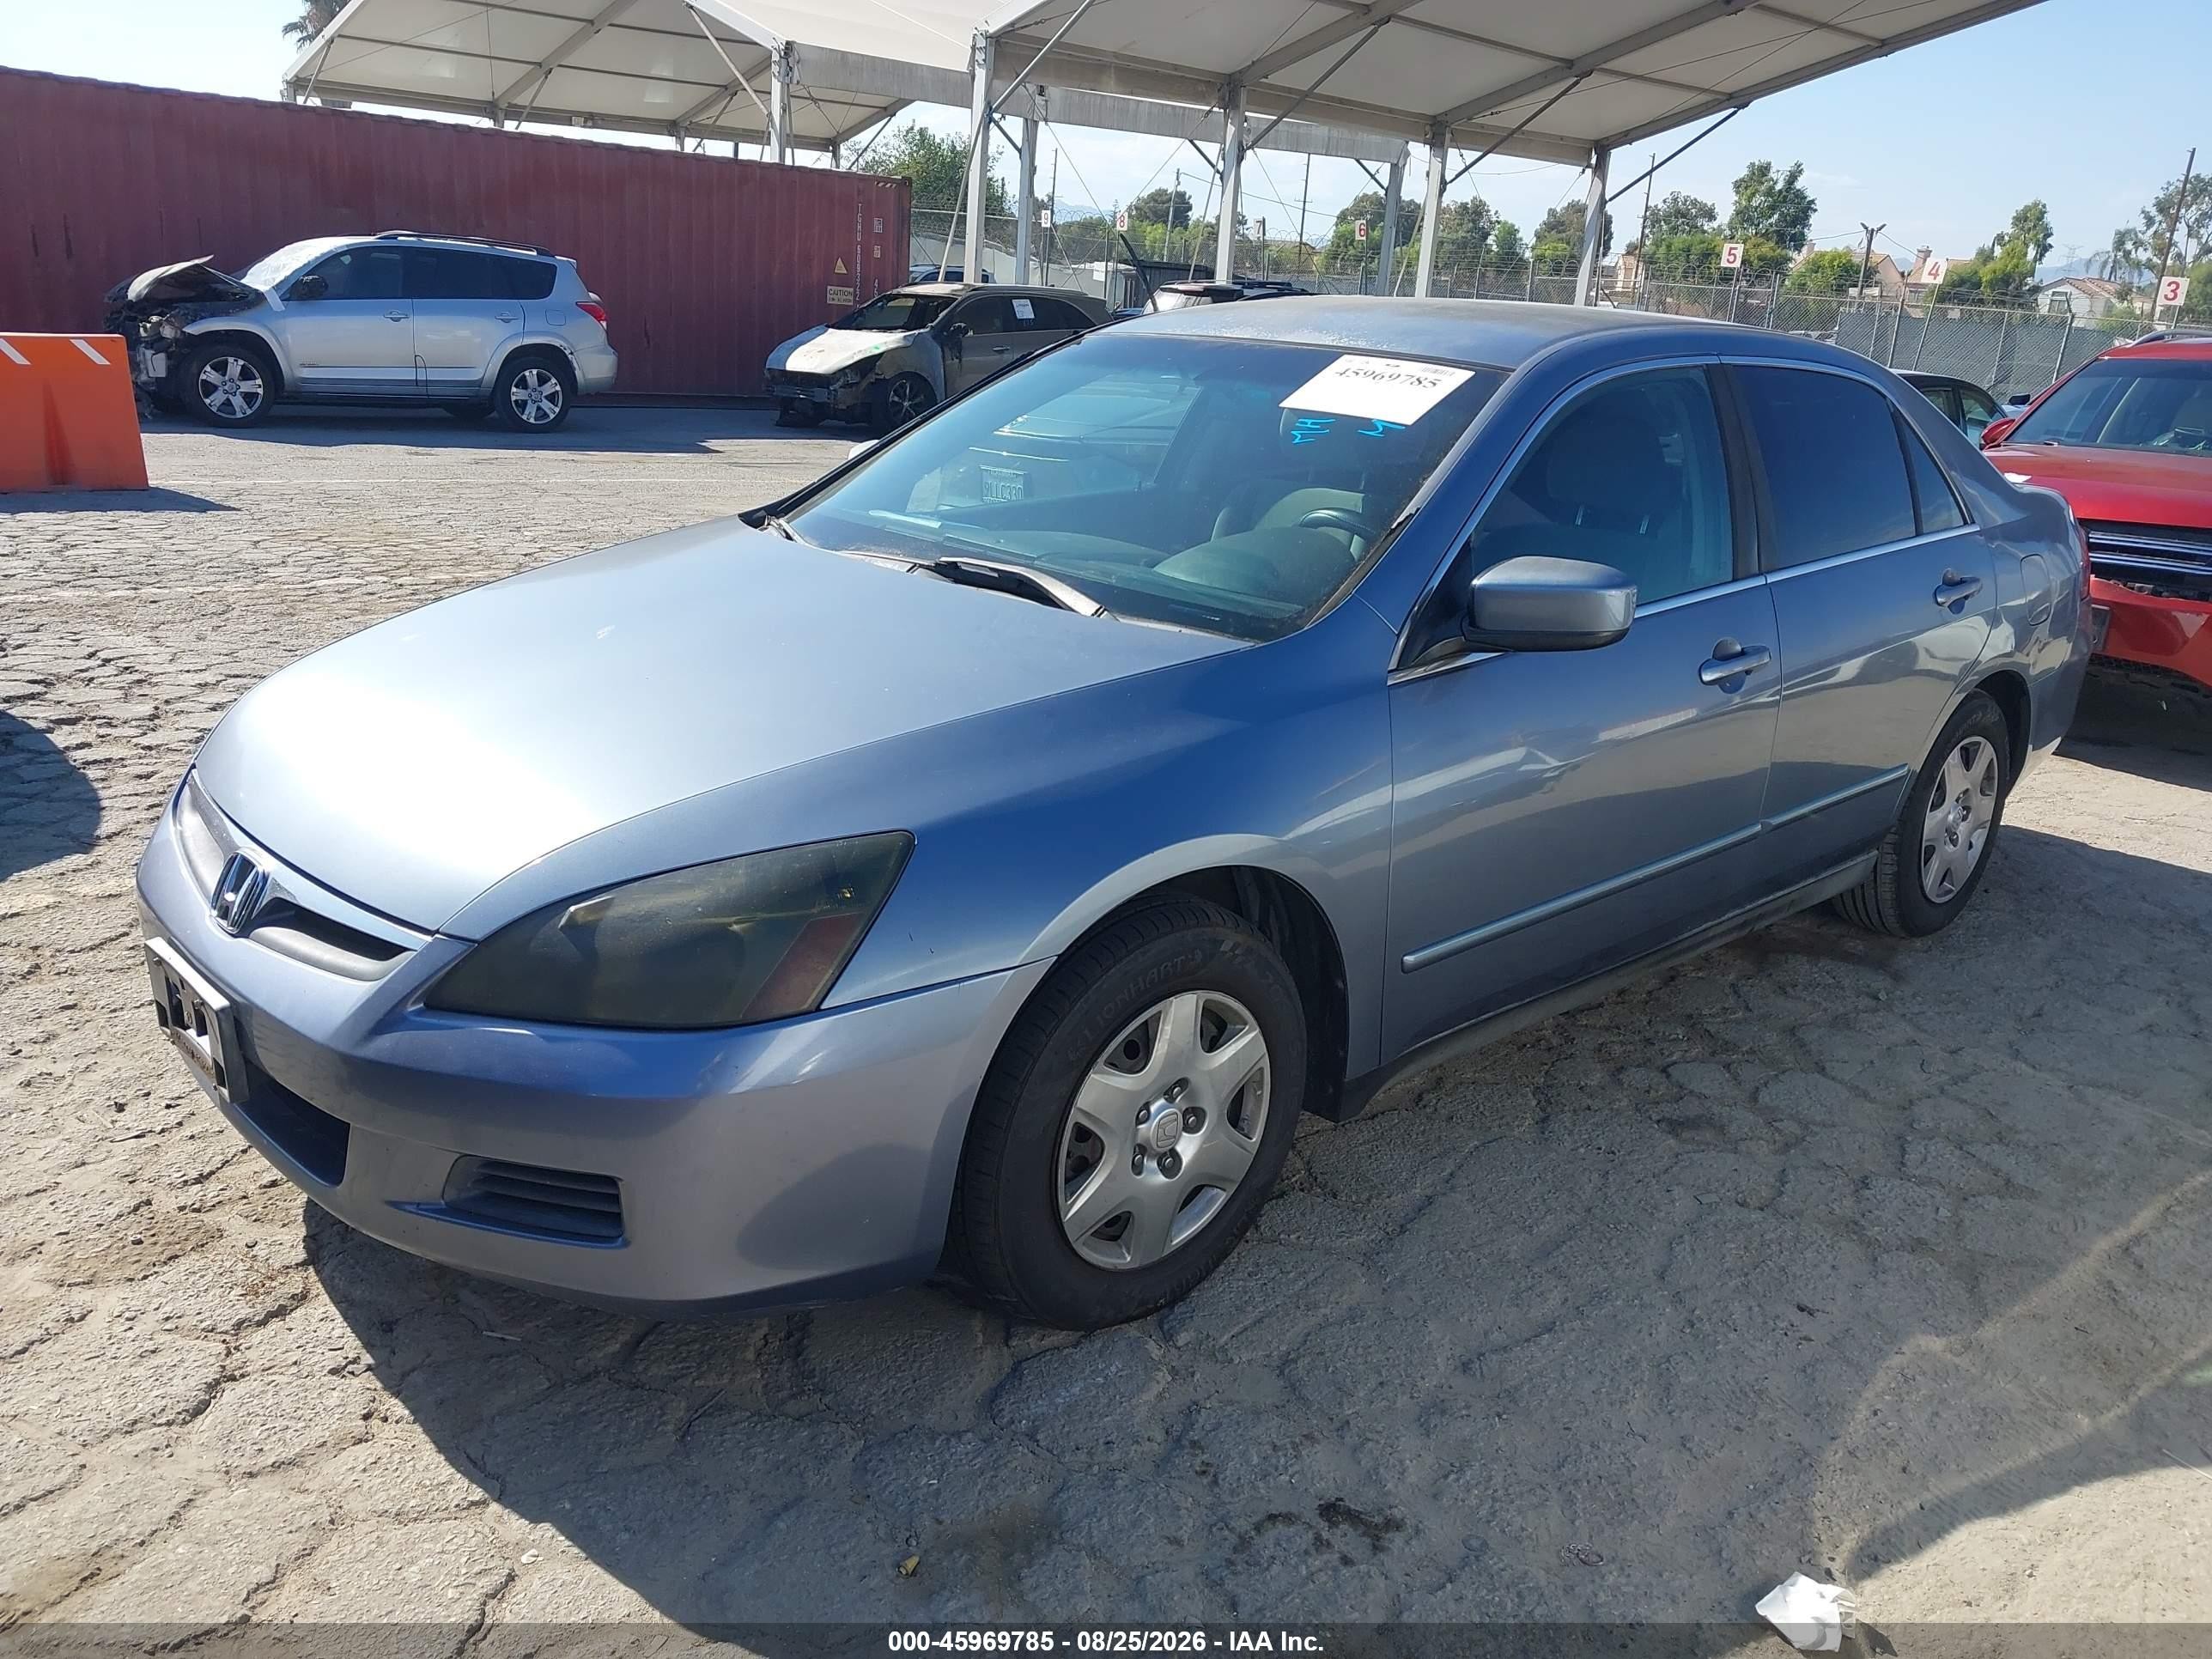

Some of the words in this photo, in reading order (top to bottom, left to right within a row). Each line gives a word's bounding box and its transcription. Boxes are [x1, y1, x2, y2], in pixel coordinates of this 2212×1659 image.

[1042, 214, 1049, 226] 9
[1118, 215, 1126, 229] 8
[1255, 219, 1262, 236] 7
[1358, 222, 1366, 238] 6
[1725, 246, 1739, 265] 5
[1927, 260, 1941, 281] 4
[828, 288, 853, 299] CAUTION
[2163, 280, 2181, 302] 3
[1335, 368, 1443, 389] 45969785
